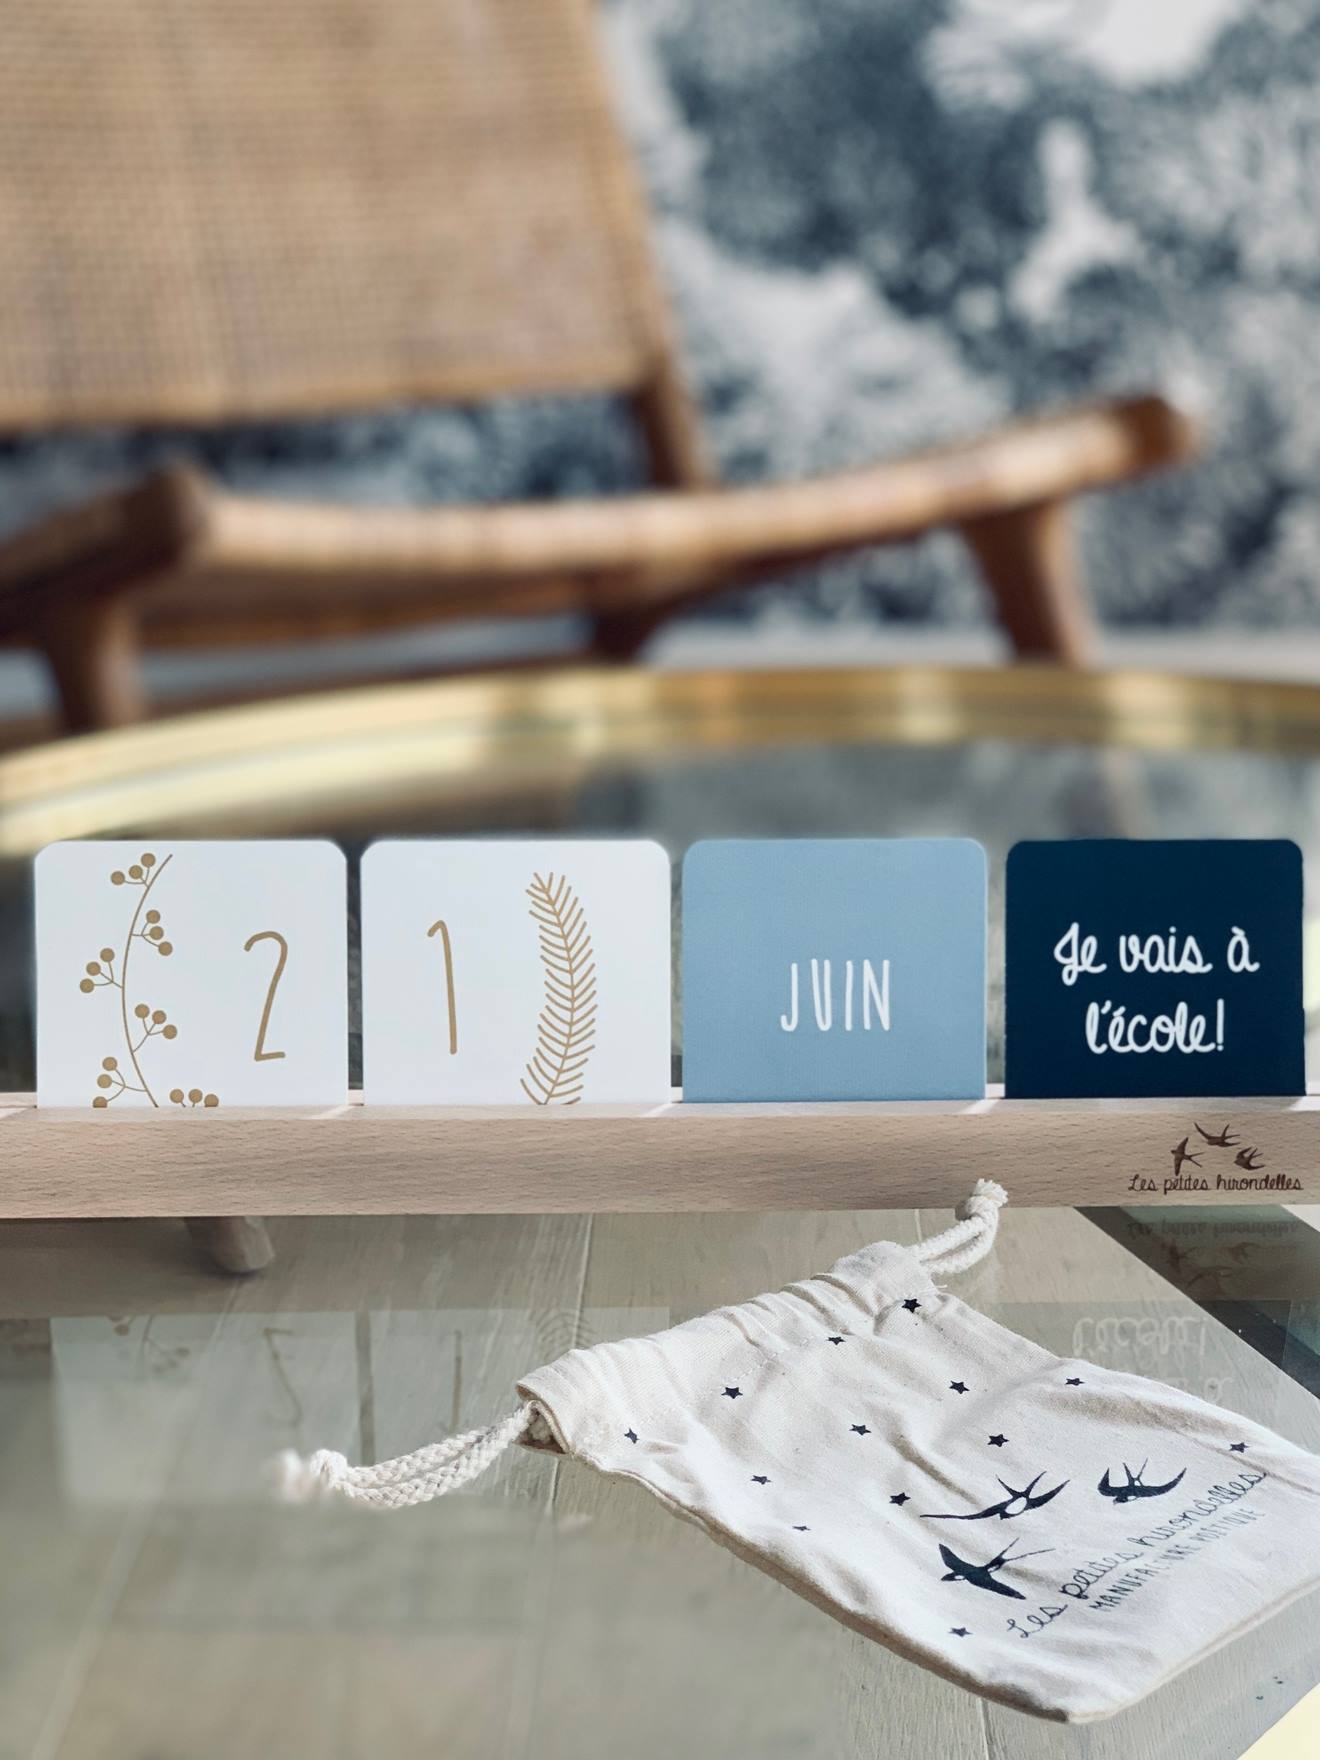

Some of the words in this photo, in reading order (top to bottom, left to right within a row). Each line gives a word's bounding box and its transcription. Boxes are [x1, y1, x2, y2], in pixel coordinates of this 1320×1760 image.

[1053, 922, 1107, 986] Je
[1119, 926, 1213, 974] vais
[1227, 926, 1260, 973] à
[243, 930, 288, 1062] 2
[426, 919, 458, 1056] 1
[779, 958, 891, 1032] JUIN
[1085, 998, 1226, 1055] l'école!
[1127, 1173, 1159, 1192] Les
[1163, 1173, 1212, 1196] petites
[1216, 1173, 1305, 1191] hirondelles
[1006, 1603, 1069, 1639] Les
